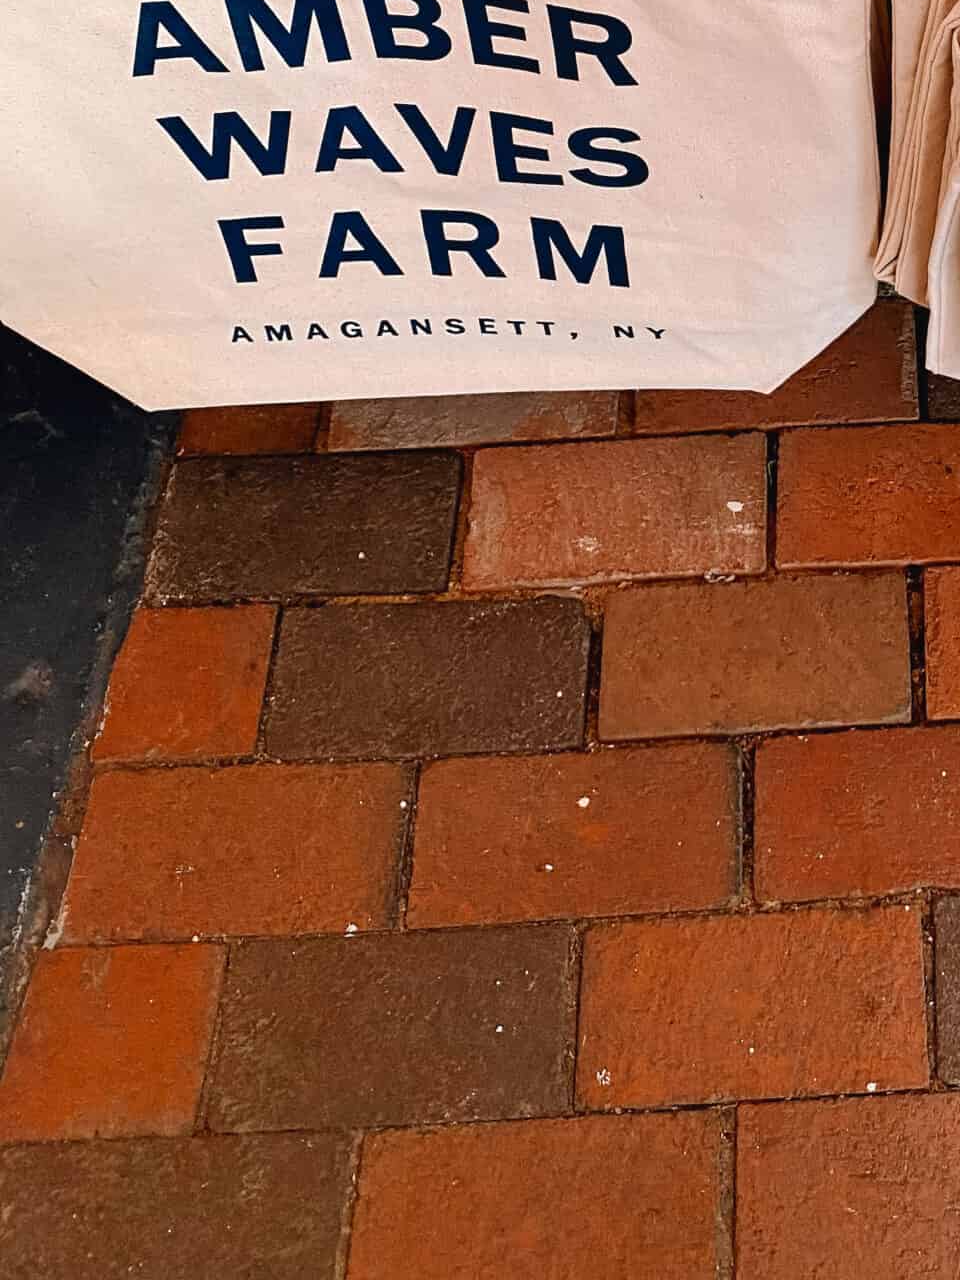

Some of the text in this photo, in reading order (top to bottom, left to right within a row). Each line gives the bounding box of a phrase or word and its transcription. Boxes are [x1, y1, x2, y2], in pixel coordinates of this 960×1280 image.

[155, 103, 649, 188] WAVES
[217, 209, 630, 288] FARM
[231, 318, 665, 343] AMAGANSETT, NY
